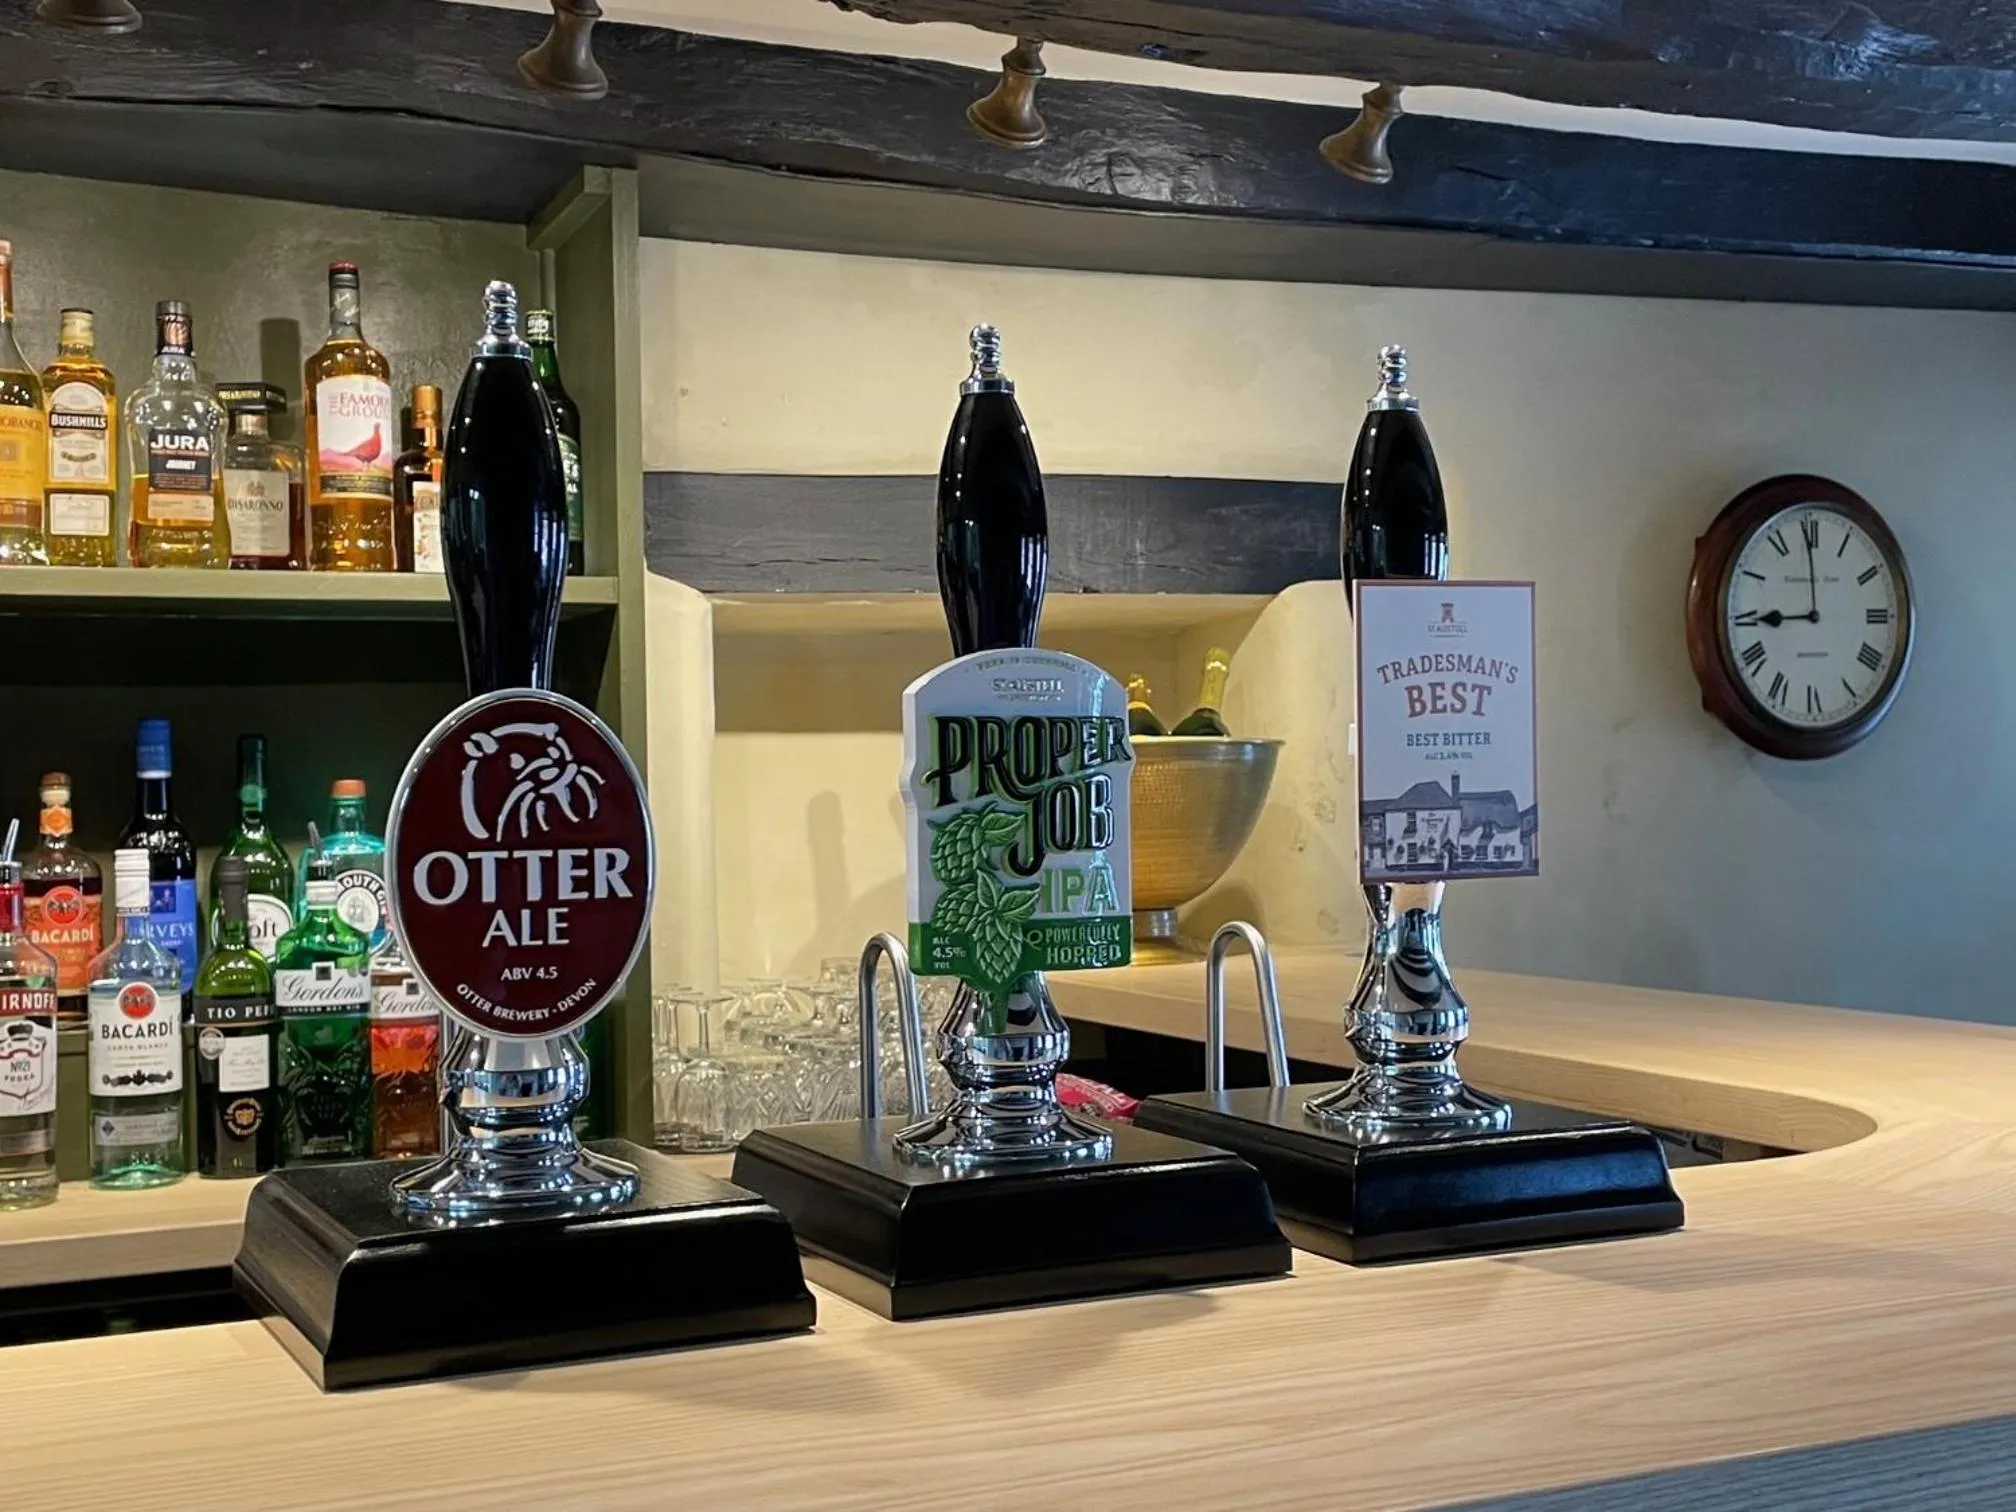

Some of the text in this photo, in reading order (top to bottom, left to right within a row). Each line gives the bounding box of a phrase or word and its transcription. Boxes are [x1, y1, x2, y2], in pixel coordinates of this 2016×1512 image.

[340, 392, 388, 407] FAMOU
[51, 414, 107, 428] BUSHMILLS
[150, 434, 210, 451] JURA
[228, 498, 284, 512] DISARONNO
[1376, 653, 1519, 684] TRADESMAN'S
[1404, 681, 1492, 718] BEST
[1407, 732, 1491, 746] BEST BITTER
[921, 715, 1132, 806] PROPER
[1003, 775, 1115, 877] JOB
[343, 875, 380, 892] OUTH
[413, 848, 634, 905] OTTER
[1041, 866, 1119, 914] IPA
[248, 919, 277, 938] oft
[482, 907, 570, 947] ALE
[932, 946, 967, 959] 4.5%
[1046, 944, 1122, 965] HOPPED
[501, 966, 558, 981] ABV 4.5
[2, 991, 56, 1010] IRNOFF
[456, 983, 493, 1013] OTTER
[493, 1005, 550, 1021] BREWERY
[557, 978, 597, 1012] DEVON
[207, 1007, 236, 1019] TIO
